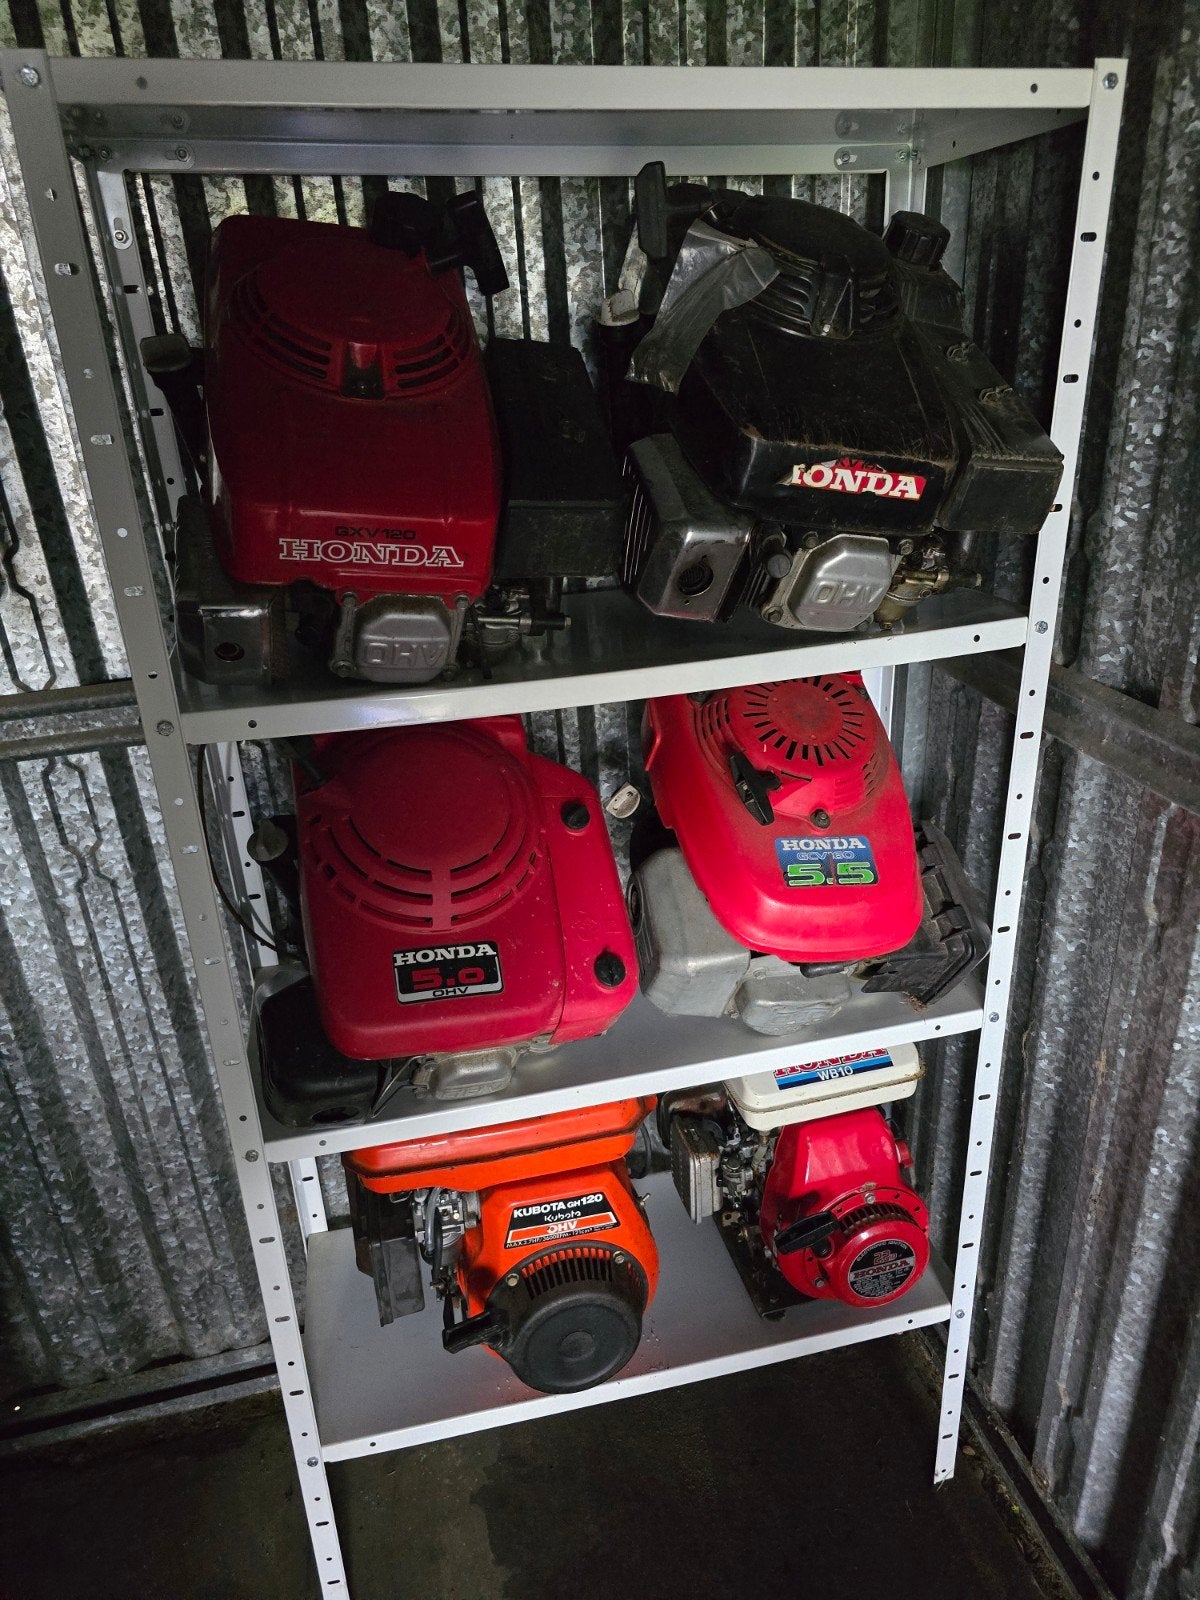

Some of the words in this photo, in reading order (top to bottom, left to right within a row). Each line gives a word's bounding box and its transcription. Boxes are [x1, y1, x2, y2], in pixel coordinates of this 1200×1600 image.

[279, 538, 464, 567] HONDA
[780, 838, 867, 851] HONDA
[787, 861, 875, 887] 5.5
[393, 943, 498, 966] HONDA
[412, 966, 486, 990] 5.0
[432, 986, 469, 997] OHV
[816, 1065, 854, 1081] WB10
[513, 1200, 567, 1218] KUBOTA
[544, 1209, 582, 1223] Kubota
[546, 1220, 578, 1234] OHV
[853, 1259, 911, 1279] HONDA
